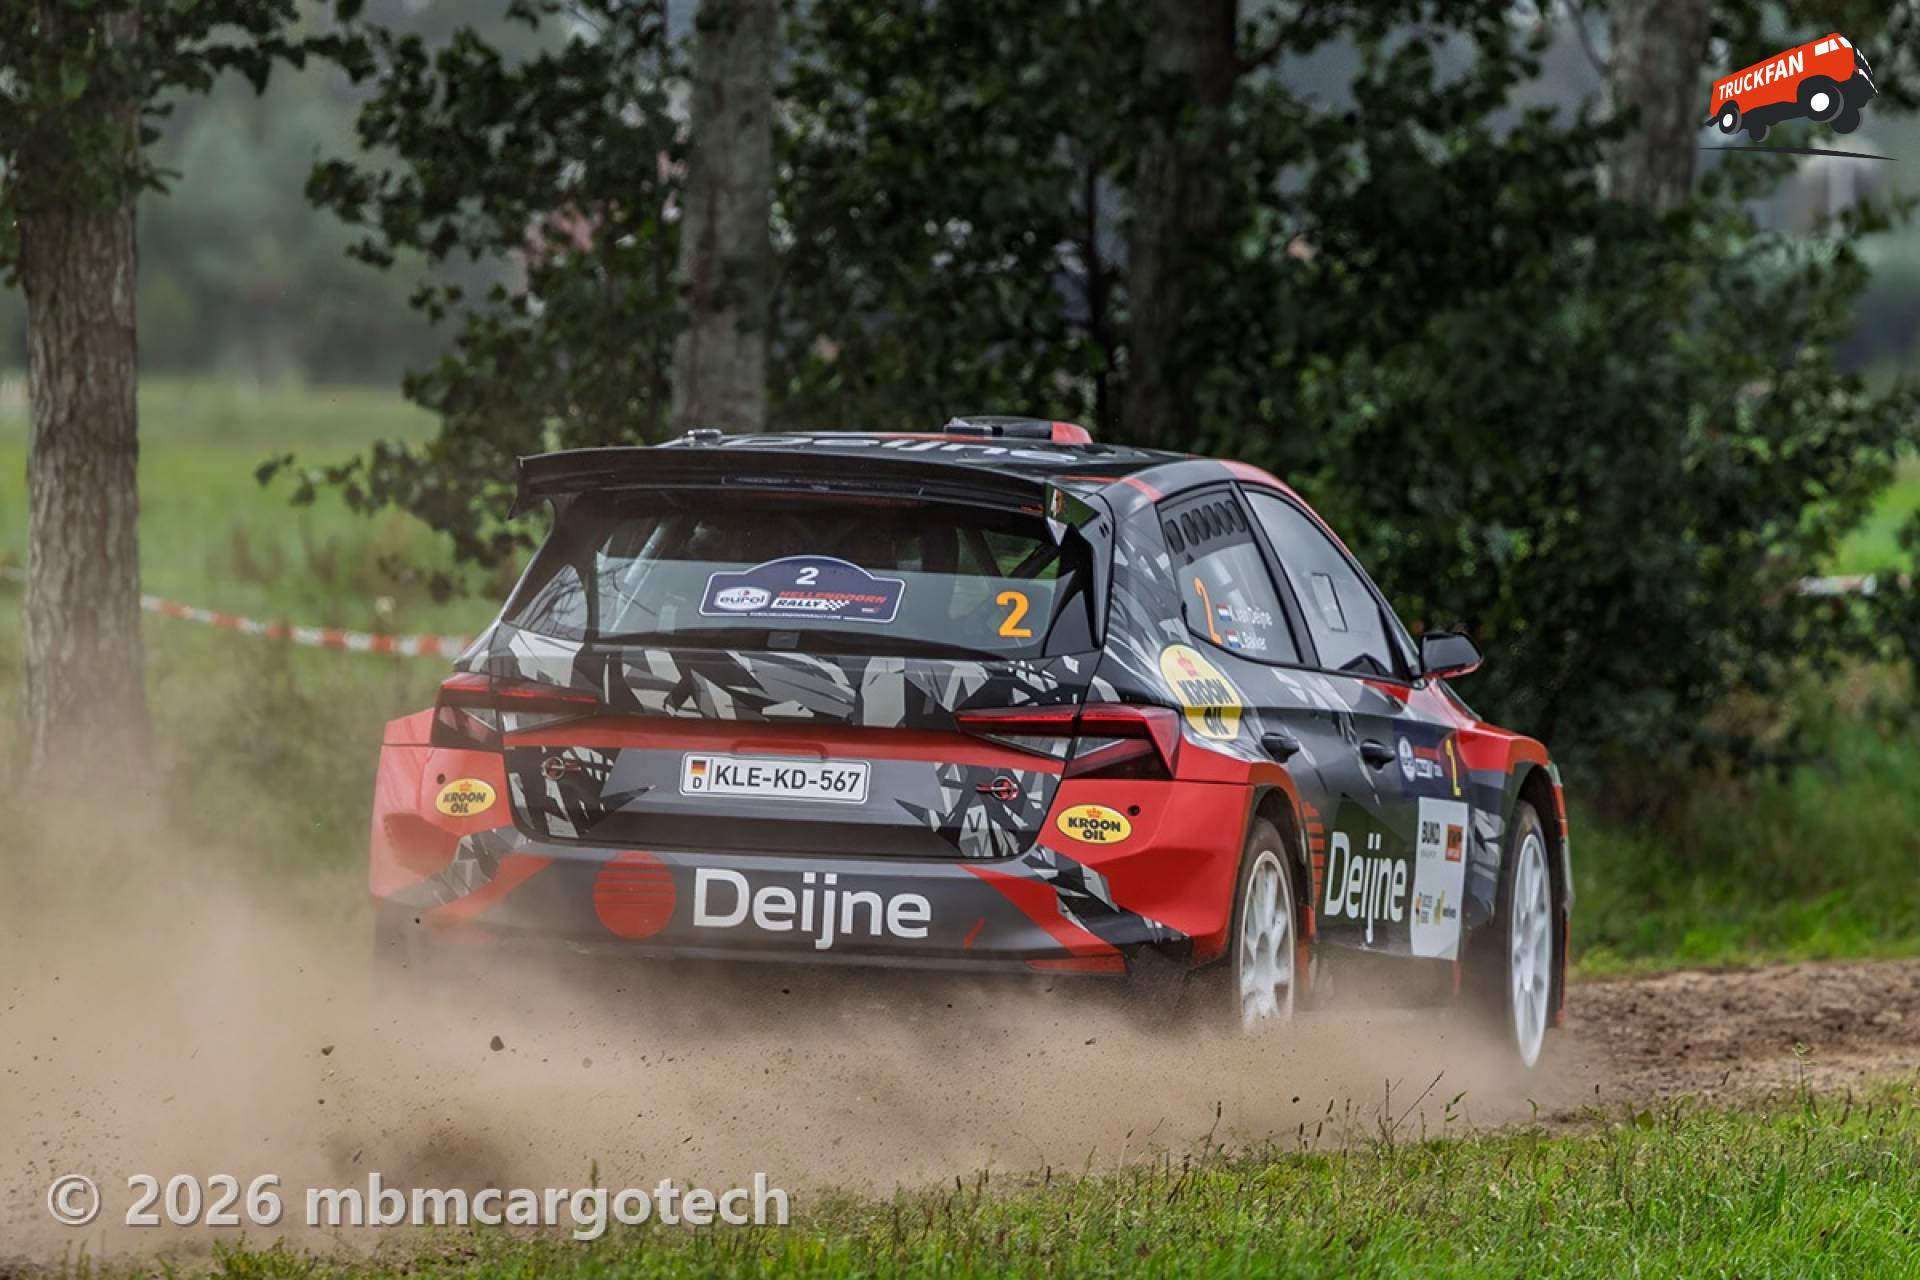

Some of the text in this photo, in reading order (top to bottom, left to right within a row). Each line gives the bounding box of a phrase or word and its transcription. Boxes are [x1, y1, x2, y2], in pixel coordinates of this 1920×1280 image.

[795, 567, 819, 585] 2
[776, 599, 823, 609] RALLY
[996, 591, 1032, 637] 2
[1193, 576, 1223, 645] 2
[1177, 679, 1235, 706] KROON
[1203, 707, 1230, 736] OIL
[692, 764, 861, 793] D KLE-KD-567
[1445, 739, 1461, 796] 2
[443, 791, 487, 804] KROON
[450, 802, 469, 814] OIL
[1068, 816, 1121, 832] KROON
[1082, 829, 1106, 841] OIL
[1324, 831, 1407, 943] Deijne
[693, 867, 932, 950] Deijne
